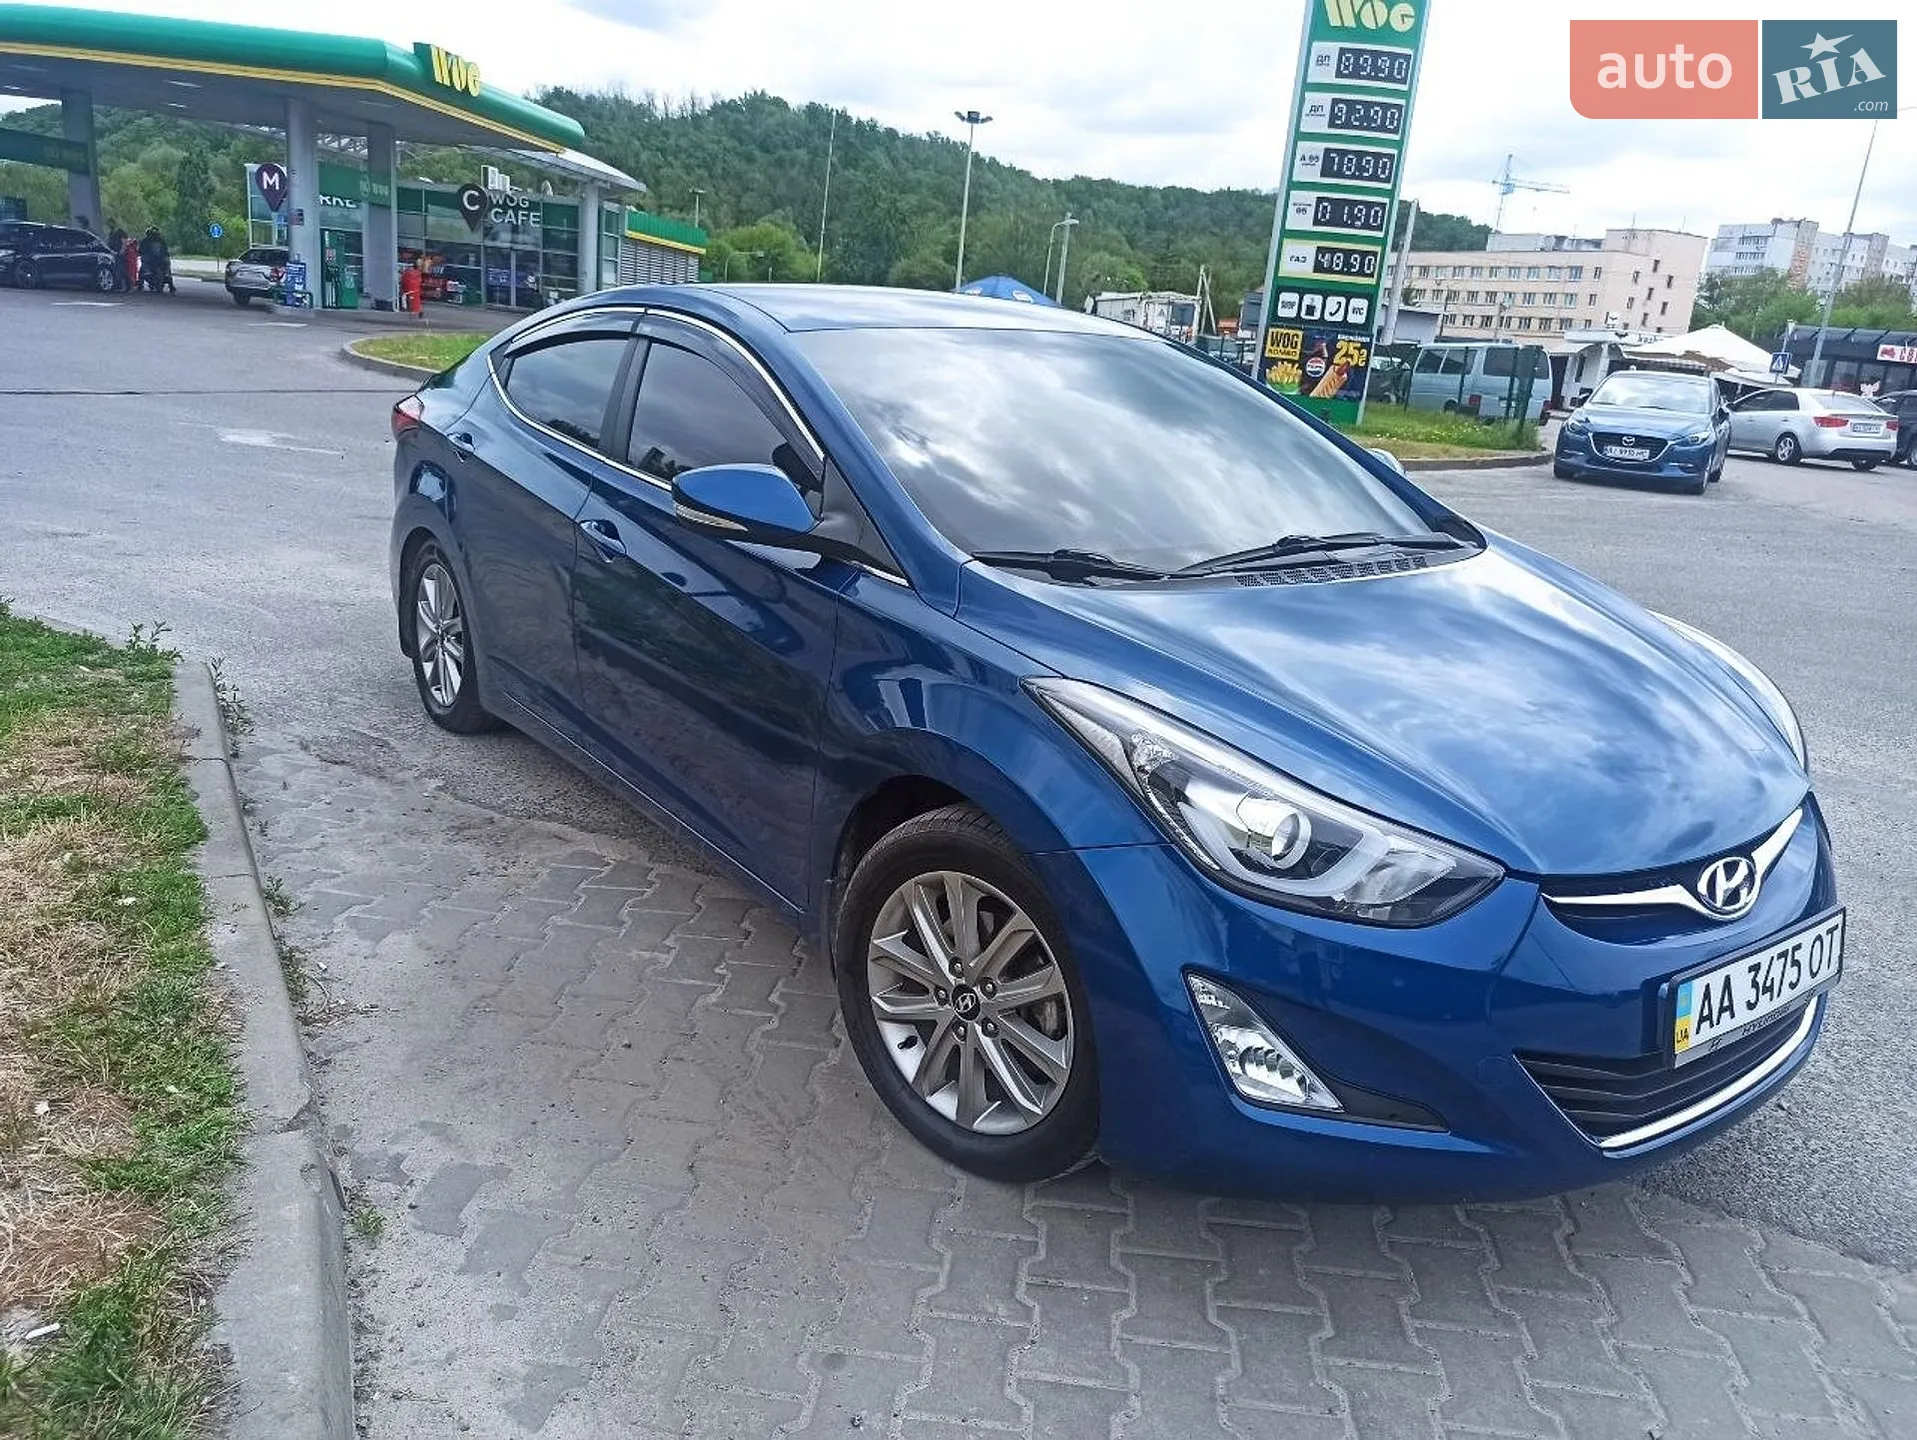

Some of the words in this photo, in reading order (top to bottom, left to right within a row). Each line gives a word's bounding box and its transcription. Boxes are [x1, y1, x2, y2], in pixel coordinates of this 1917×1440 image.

[1324, 0, 1415, 32] WOG
[431, 44, 479, 97] WOG
[1334, 103, 1399, 129] 92.90
[1330, 152, 1390, 178] 78.90
[262, 171, 280, 191] M
[463, 190, 480, 210] C
[489, 190, 530, 208] WOG
[490, 208, 541, 227] CAFE
[1317, 252, 1375, 274] 48.90
[1270, 330, 1299, 350] WOG
[1696, 974, 1736, 1035] AA
[1745, 943, 1802, 1011] 3475
[1809, 924, 1839, 979] OT
